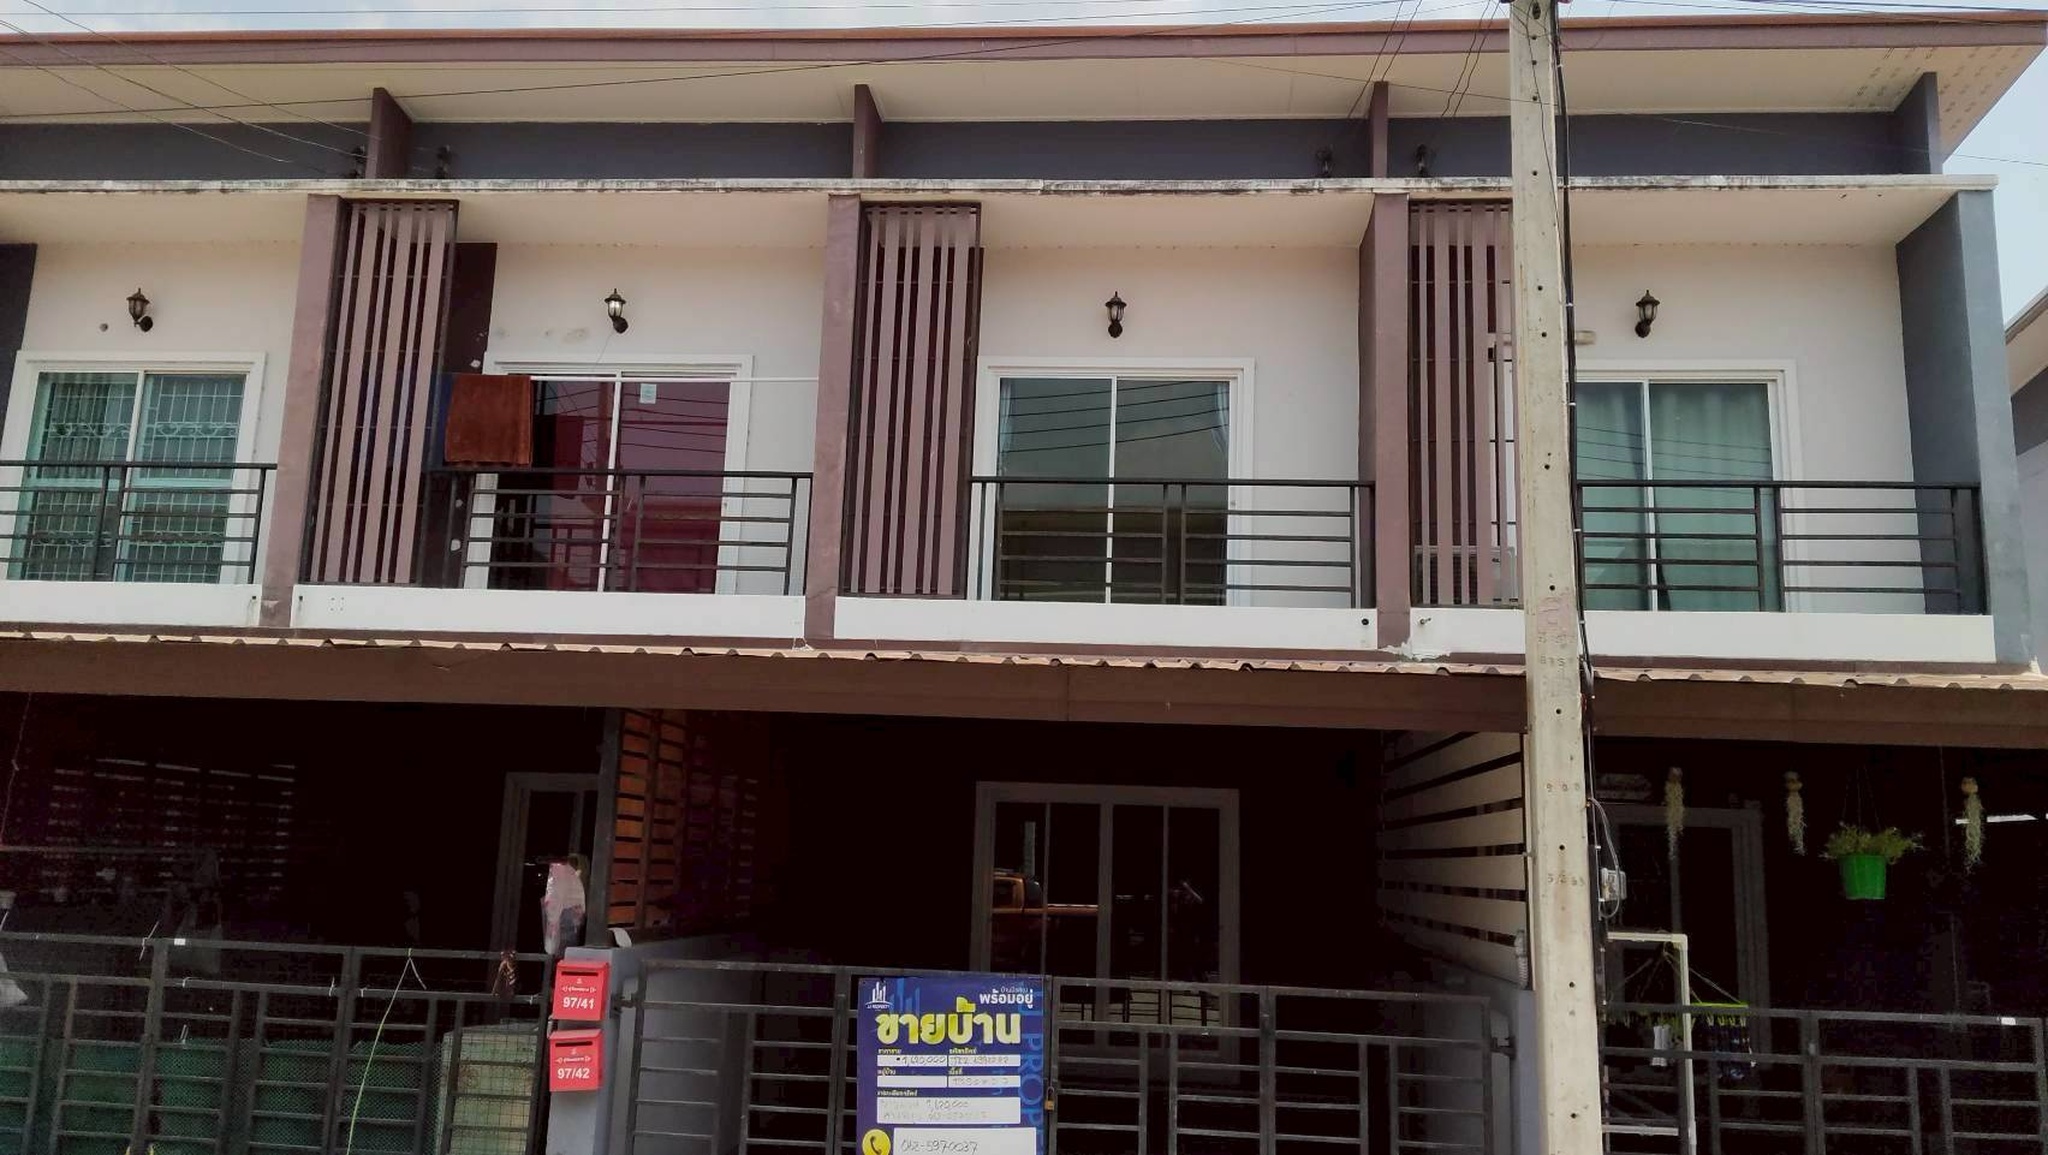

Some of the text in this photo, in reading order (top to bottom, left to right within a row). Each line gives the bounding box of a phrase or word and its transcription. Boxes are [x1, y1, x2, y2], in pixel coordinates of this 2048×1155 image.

[563, 996, 595, 1009] 97/41
[980, 988, 1034, 1009] พร้อมอยู่
[875, 996, 1022, 1045] ขายบ้าน
[557, 1067, 590, 1079] 97/42
